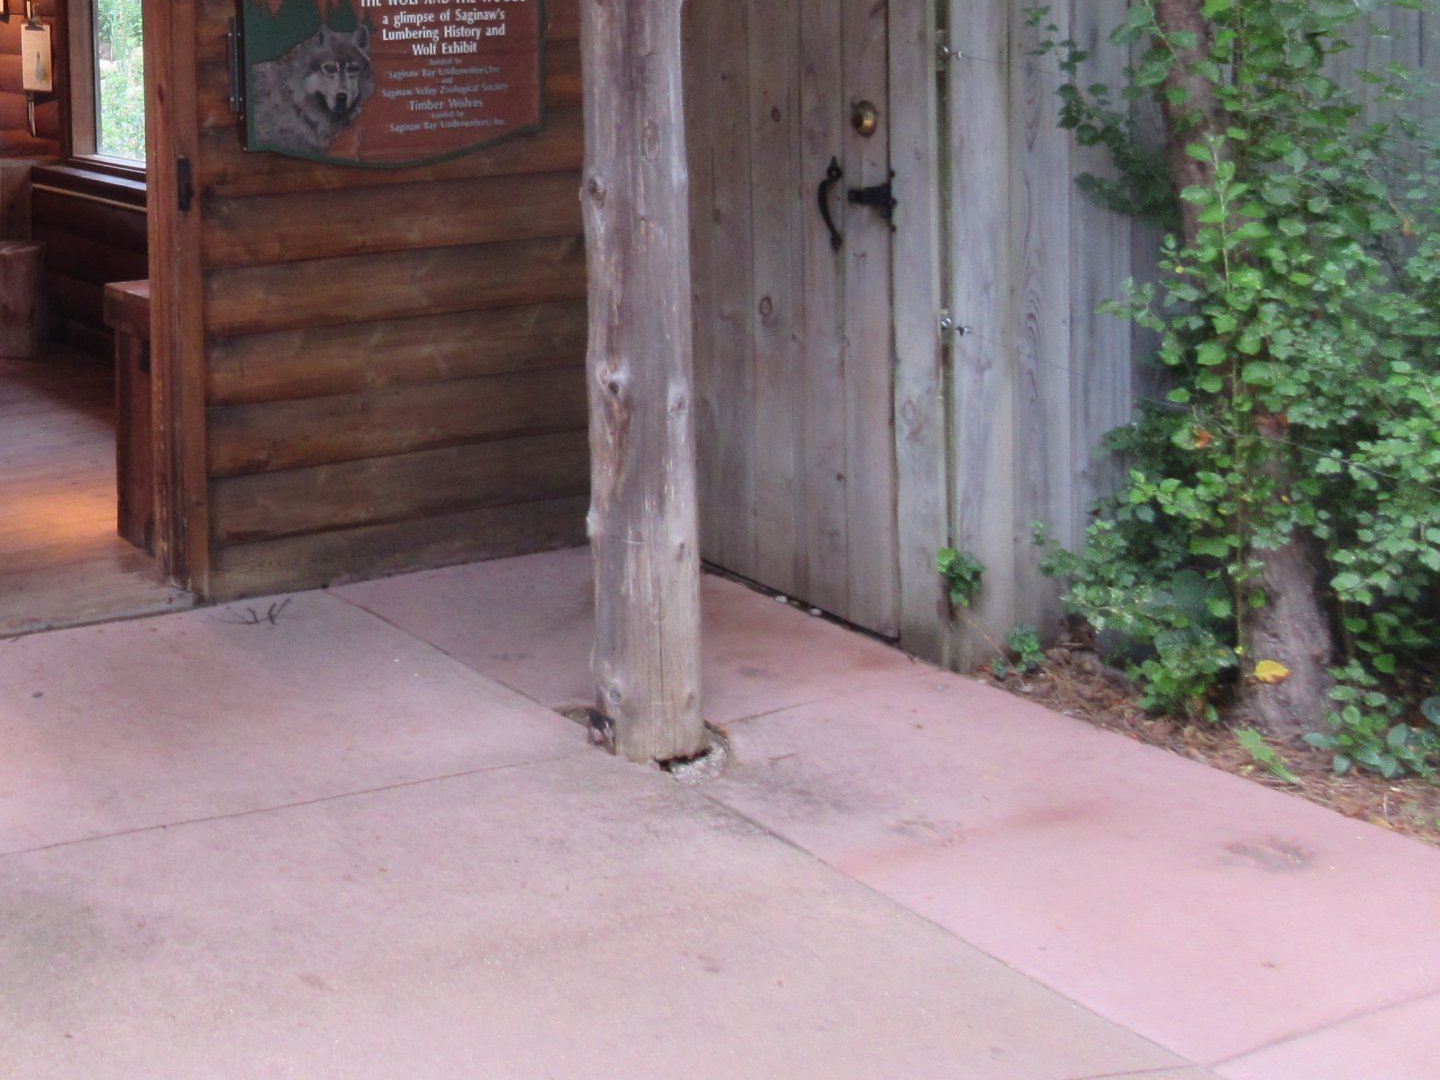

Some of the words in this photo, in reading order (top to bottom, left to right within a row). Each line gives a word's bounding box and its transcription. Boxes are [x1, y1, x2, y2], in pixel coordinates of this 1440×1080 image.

[382, 14, 389, 25] a
[394, 11, 435, 28] glimpse
[440, 9, 451, 21] of
[455, 8, 505, 24] Saginaw's
[382, 27, 439, 41] Lumbering
[444, 25, 481, 40] History
[485, 24, 505, 36] and
[412, 43, 437, 56] Wolf
[442, 41, 478, 55] Exhibit
[388, 70, 419, 80] Saginaw
[422, 68, 435, 78] Bay
[382, 88, 412, 99] Saginaw
[415, 86, 437, 96] Valley
[440, 84, 479, 95] Zoological
[481, 81, 509, 92] Society
[409, 99, 444, 111] Timber
[448, 97, 483, 109] Wolves
[390, 123, 421, 134] Saginaw
[424, 121, 437, 130] Bay
